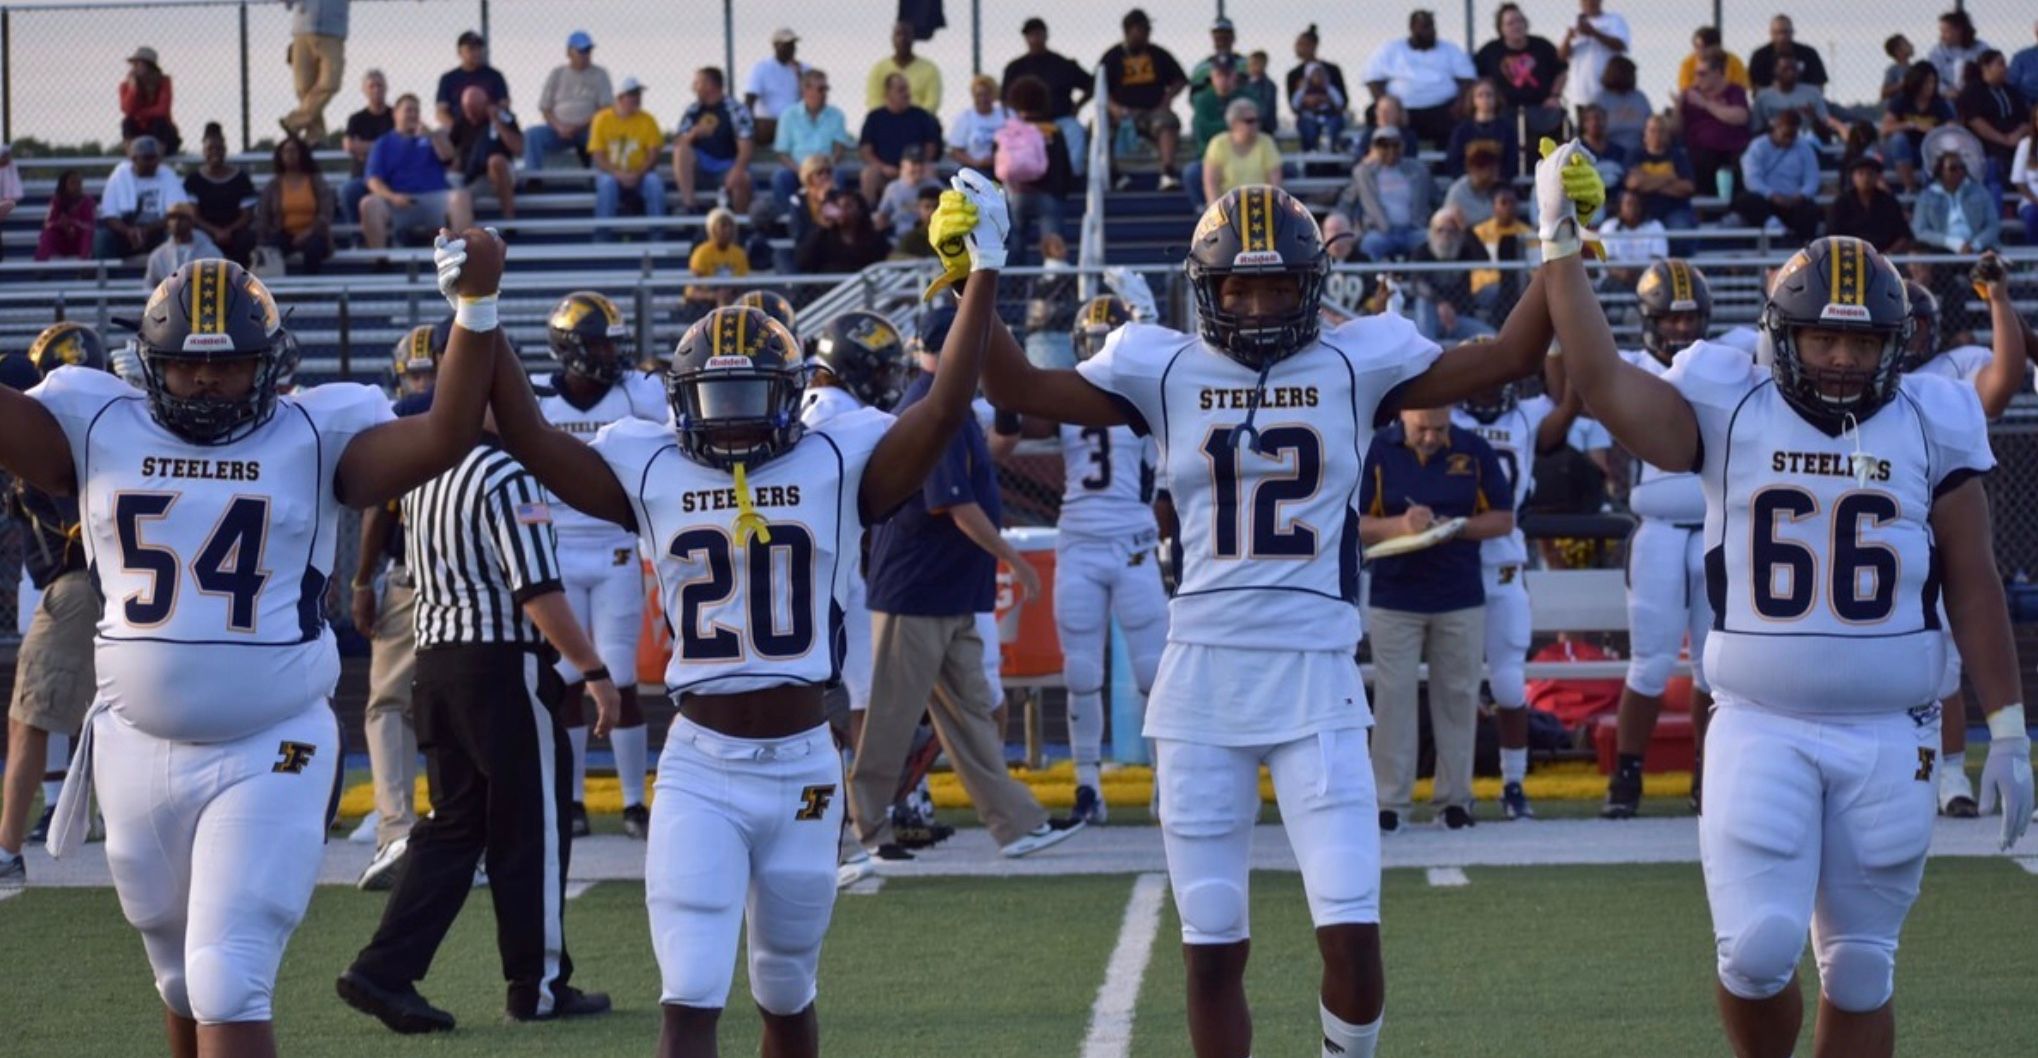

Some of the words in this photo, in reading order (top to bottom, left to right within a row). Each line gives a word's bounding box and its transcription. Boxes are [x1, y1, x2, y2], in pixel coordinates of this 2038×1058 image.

[1239, 254, 1278, 264] Riddell
[1828, 306, 1865, 317] Riddell
[710, 357, 748, 367] Riddell
[141, 456, 261, 481] STEELERS
[1079, 426, 1112, 490] 3
[682, 485, 801, 513] STEEERS
[1199, 422, 1325, 560] 12
[113, 489, 273, 633] 54
[1749, 484, 1901, 626] 66
[667, 520, 816, 664] 20
